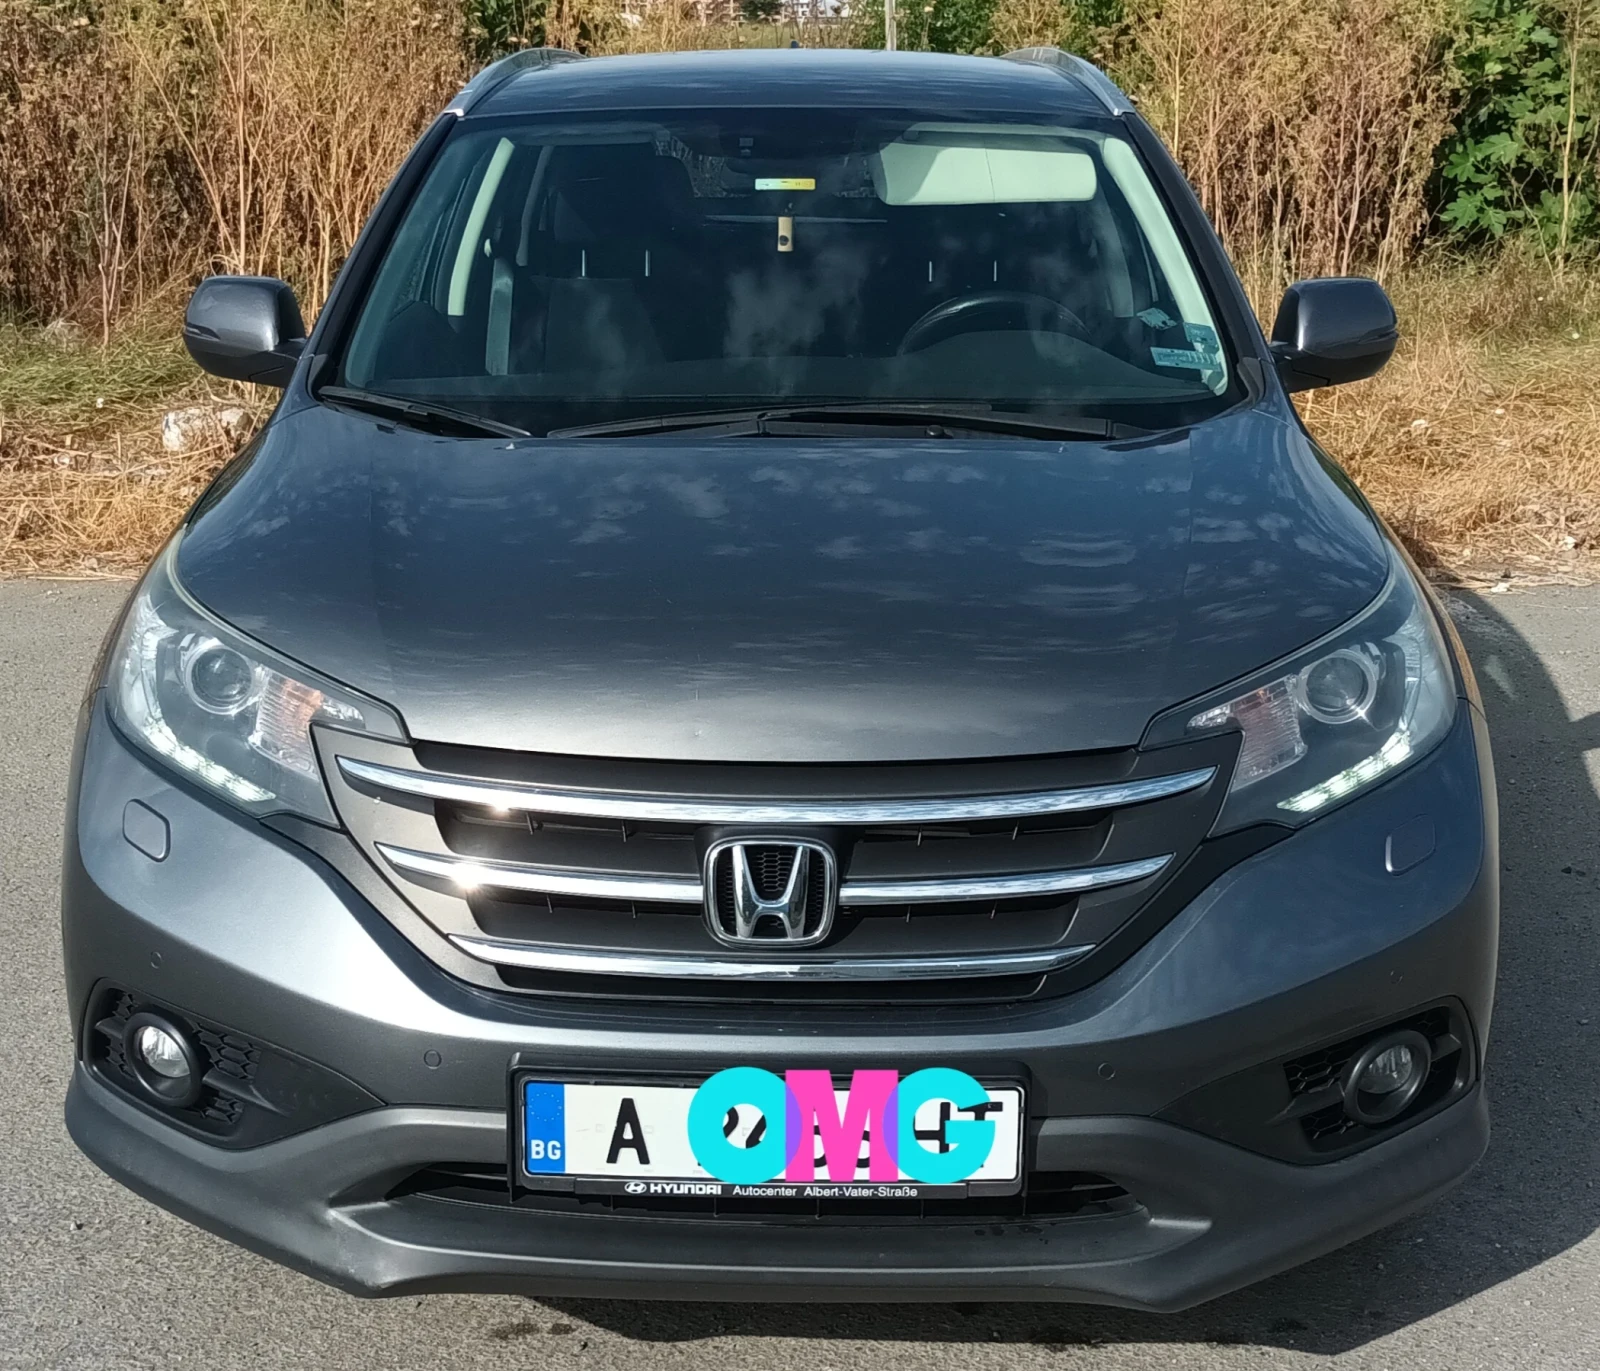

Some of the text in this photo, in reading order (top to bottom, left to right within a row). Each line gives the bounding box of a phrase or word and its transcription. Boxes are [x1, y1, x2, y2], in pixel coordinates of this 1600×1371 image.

[605, 1097, 651, 1165] A
[530, 1139, 562, 1160] BG
[650, 1182, 918, 1198] HYUNDAI Autocenter Albert-Vater-Straße
